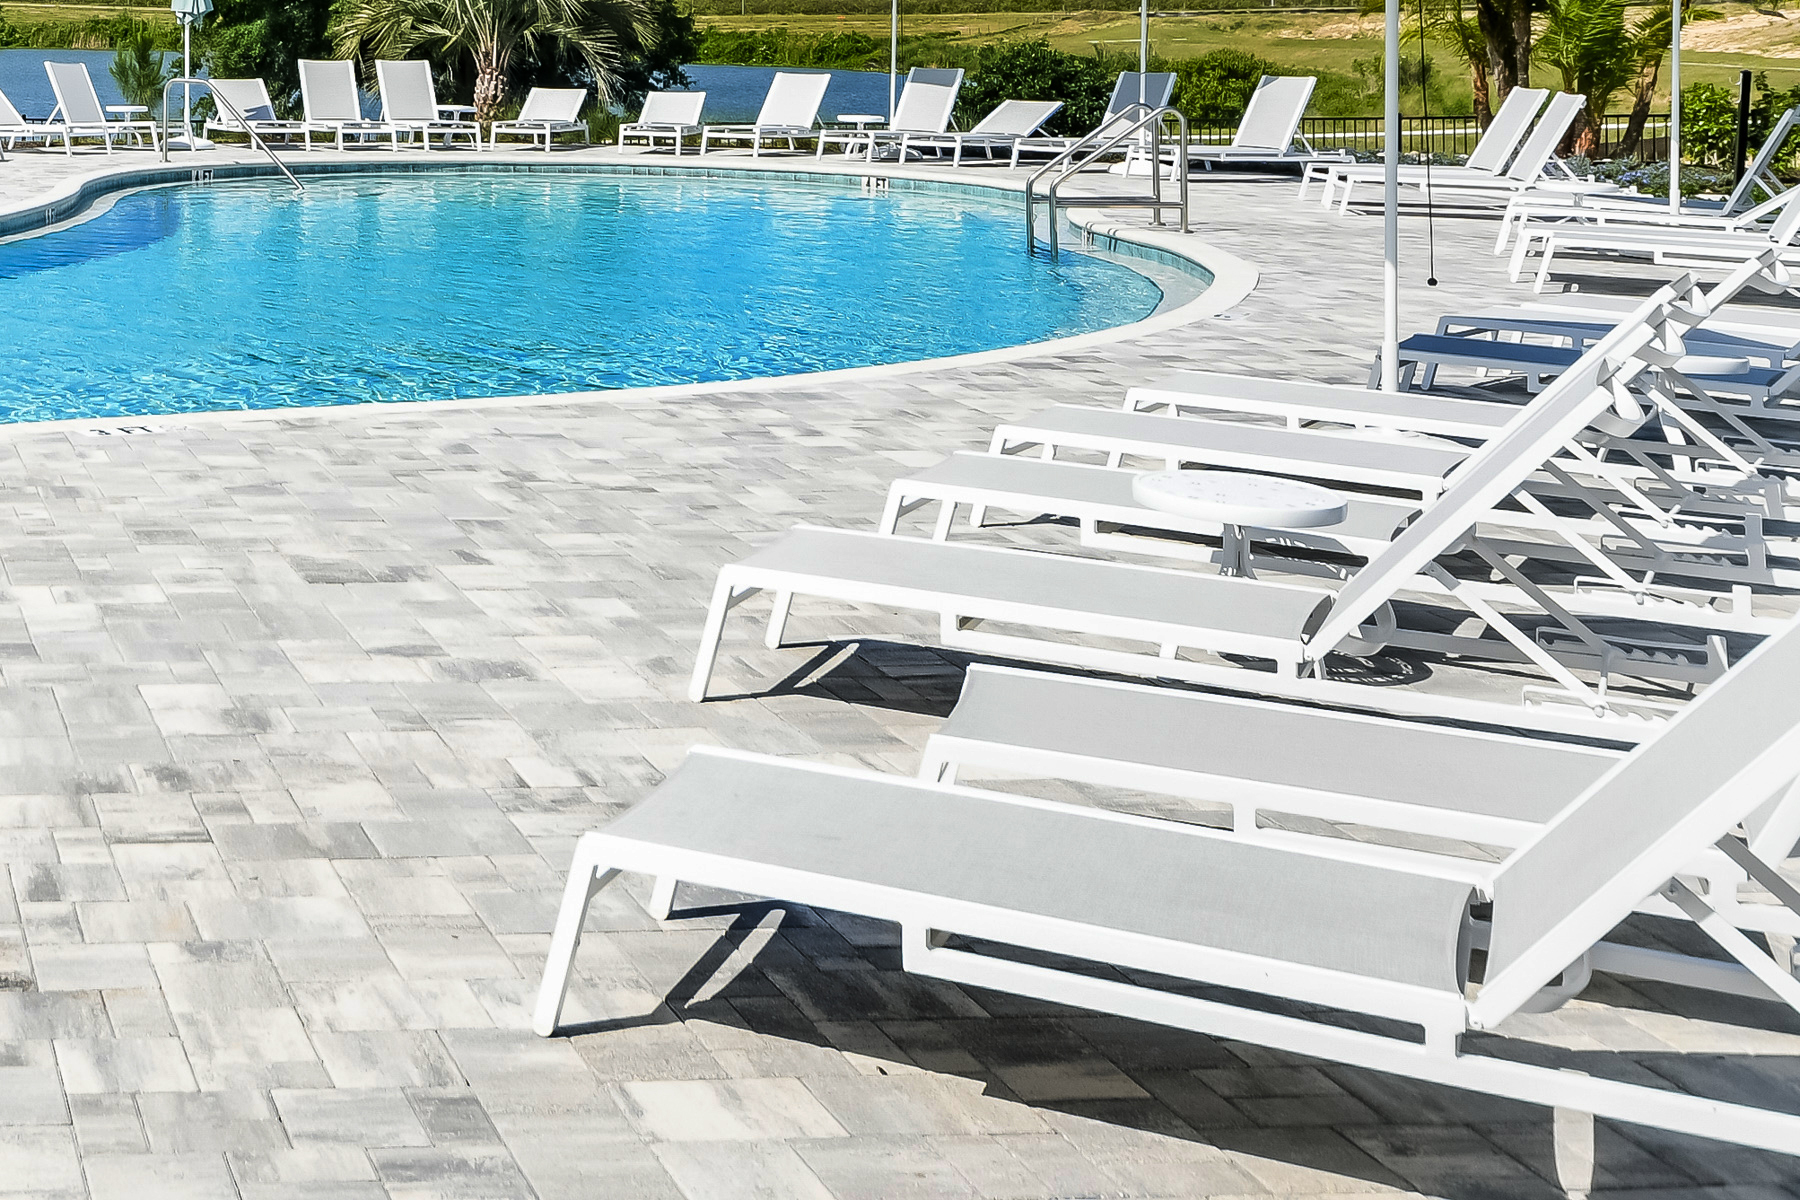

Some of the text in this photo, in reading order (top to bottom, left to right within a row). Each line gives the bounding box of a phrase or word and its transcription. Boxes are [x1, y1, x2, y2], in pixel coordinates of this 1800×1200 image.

[203, 169, 213, 181] FT
[875, 177, 887, 189] FT
[116, 425, 153, 434] FT
